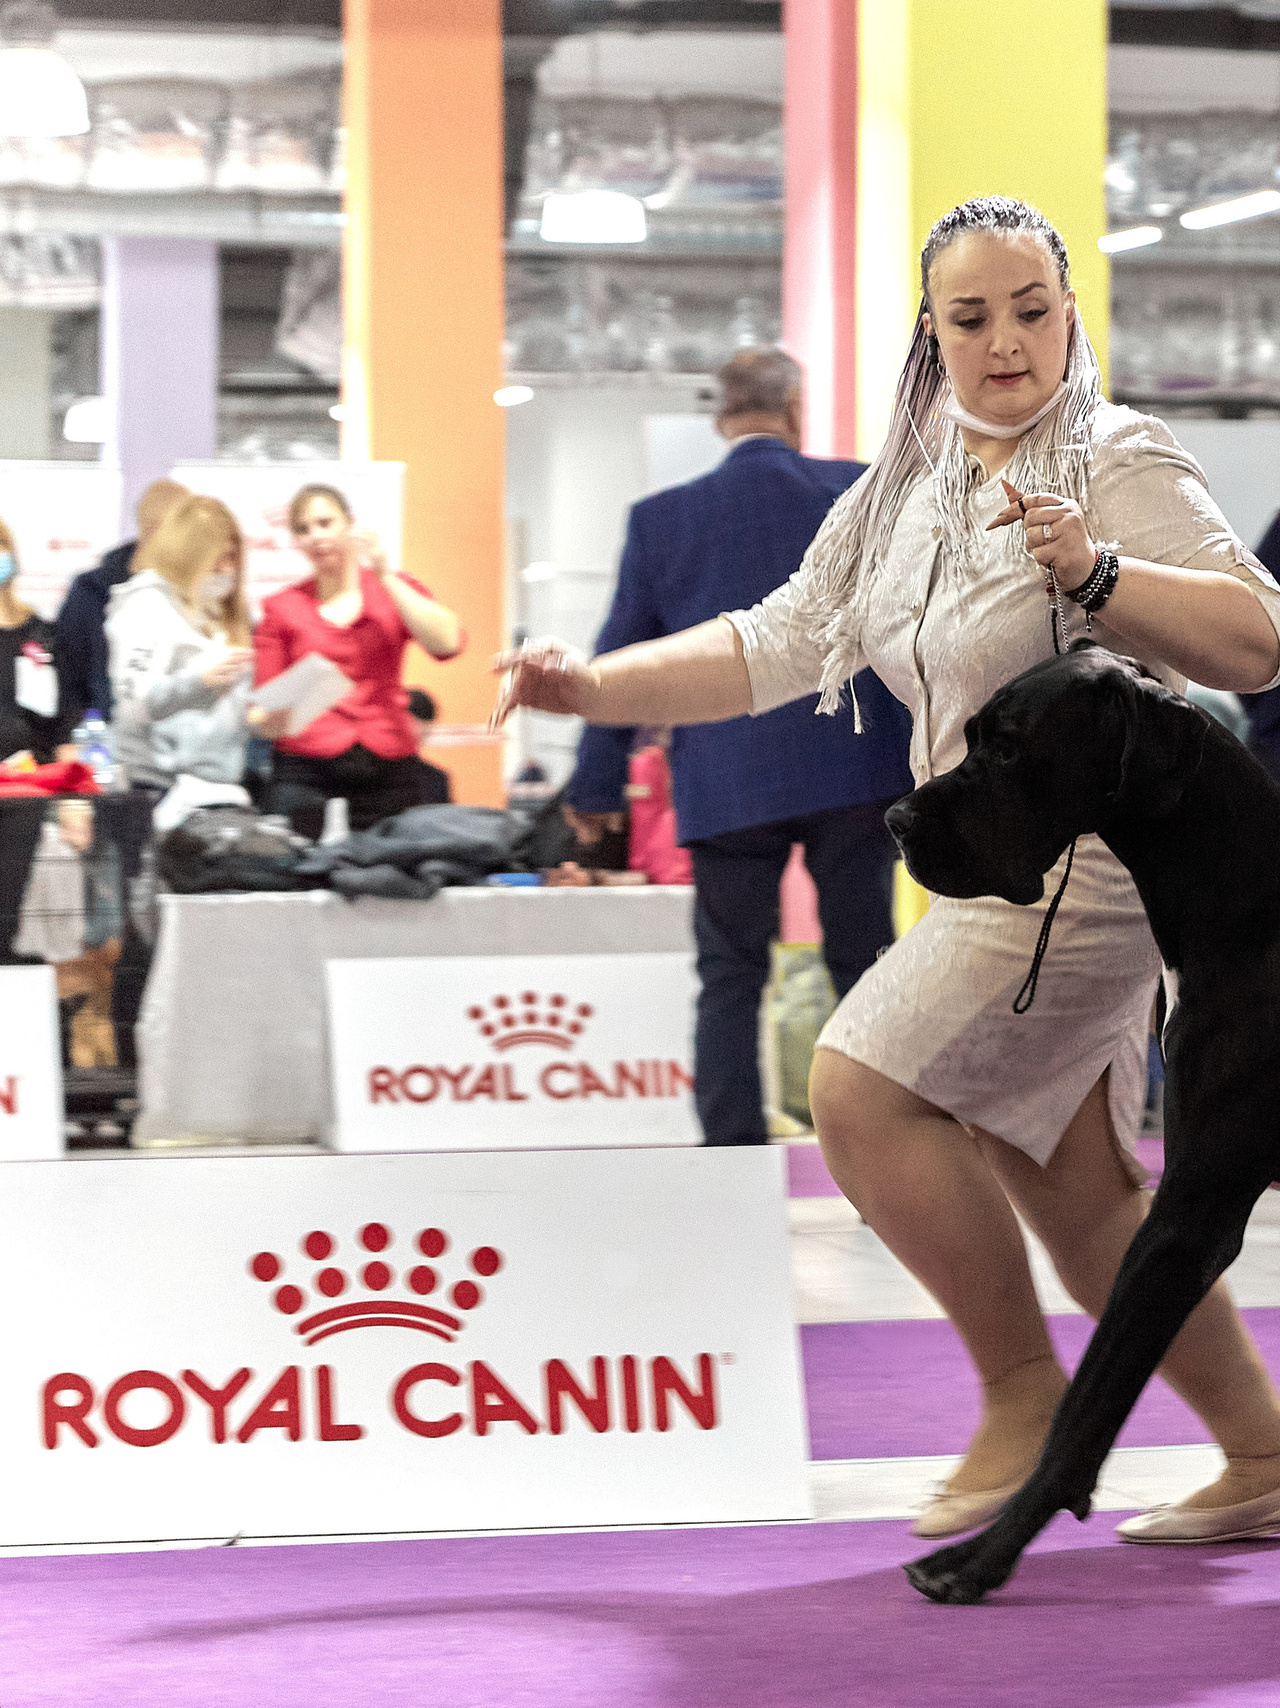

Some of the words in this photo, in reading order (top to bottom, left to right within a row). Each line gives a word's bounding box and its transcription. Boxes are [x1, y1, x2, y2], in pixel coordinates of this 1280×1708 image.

[368, 1062, 528, 1103] ROYAL
[41, 1364, 367, 1450] ROYAL
[390, 1352, 721, 1438] CANIN
